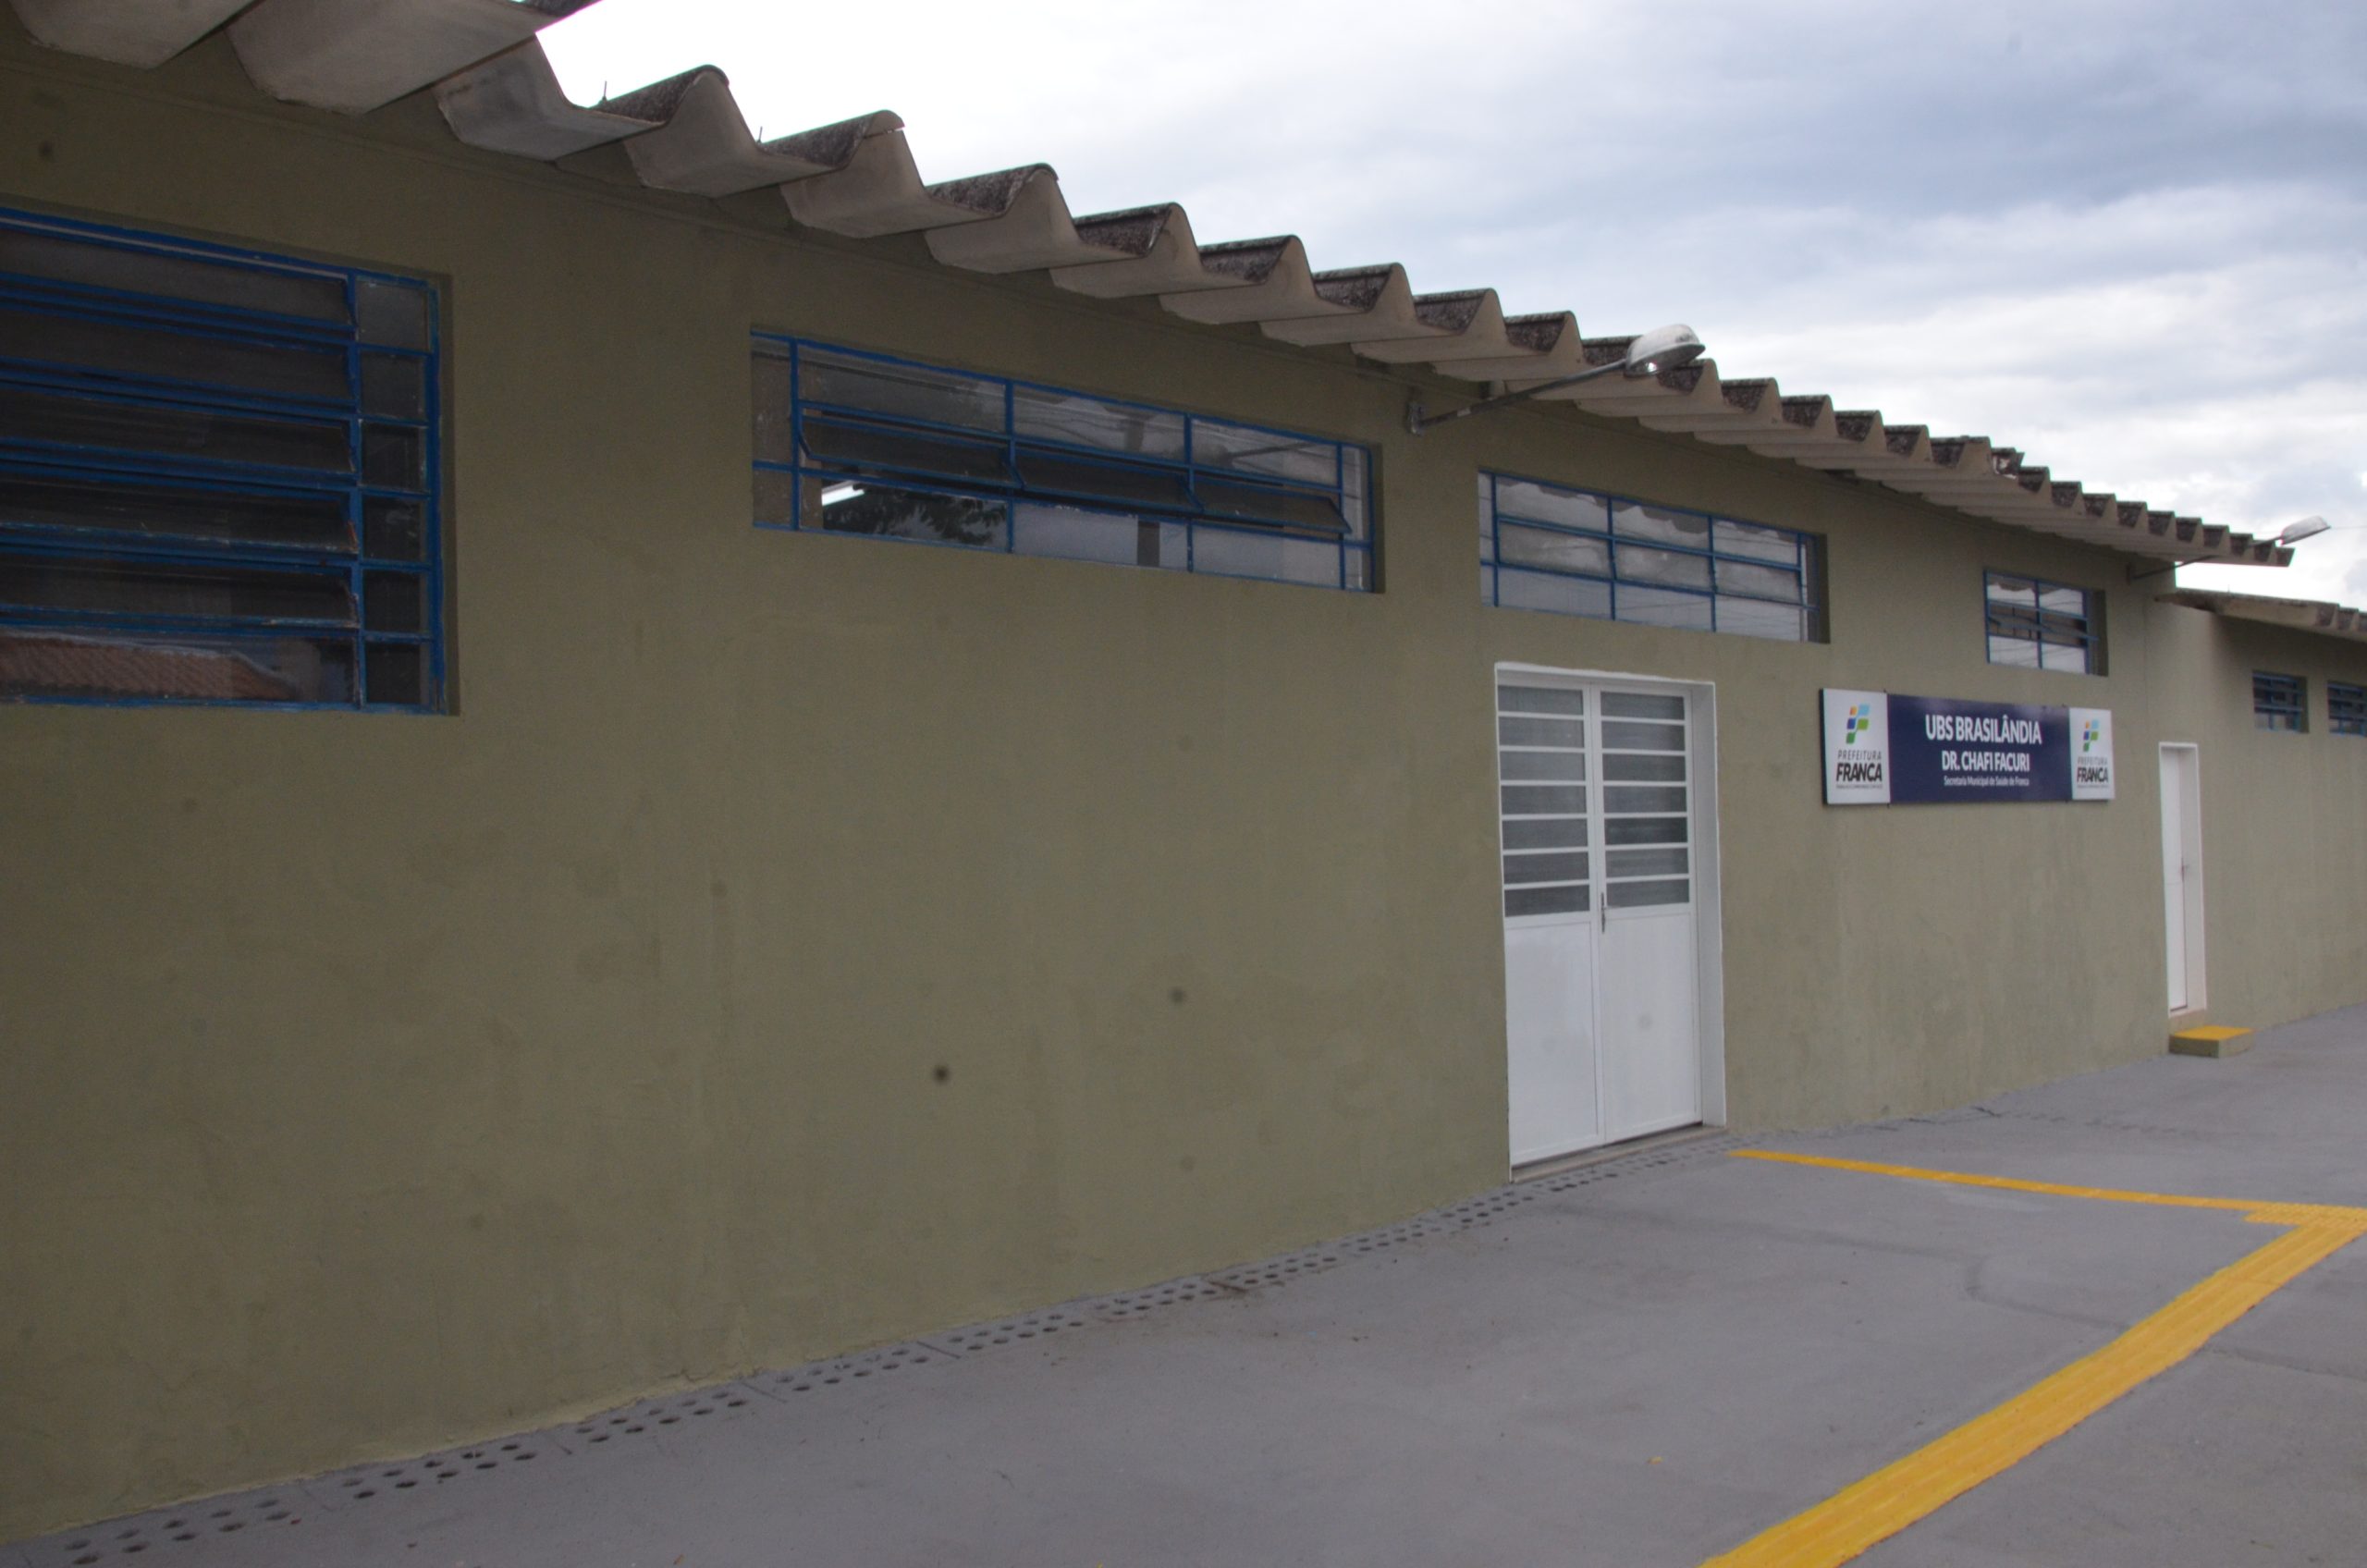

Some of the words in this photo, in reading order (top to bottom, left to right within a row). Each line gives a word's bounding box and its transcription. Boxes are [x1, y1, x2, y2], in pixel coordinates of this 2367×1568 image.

[1926, 714, 1954, 741] UBS
[1956, 714, 2042, 744] BRASILÂNDIA
[1837, 750, 1882, 761] PREFEITURA
[1942, 750, 1960, 771] DR.
[1961, 751, 1993, 771] CHAFI
[1994, 752, 2030, 772] FACURI
[1836, 763, 1883, 782] FRANCA
[1944, 775, 1968, 787] Secretaria
[2077, 766, 2109, 783] FRANCA
